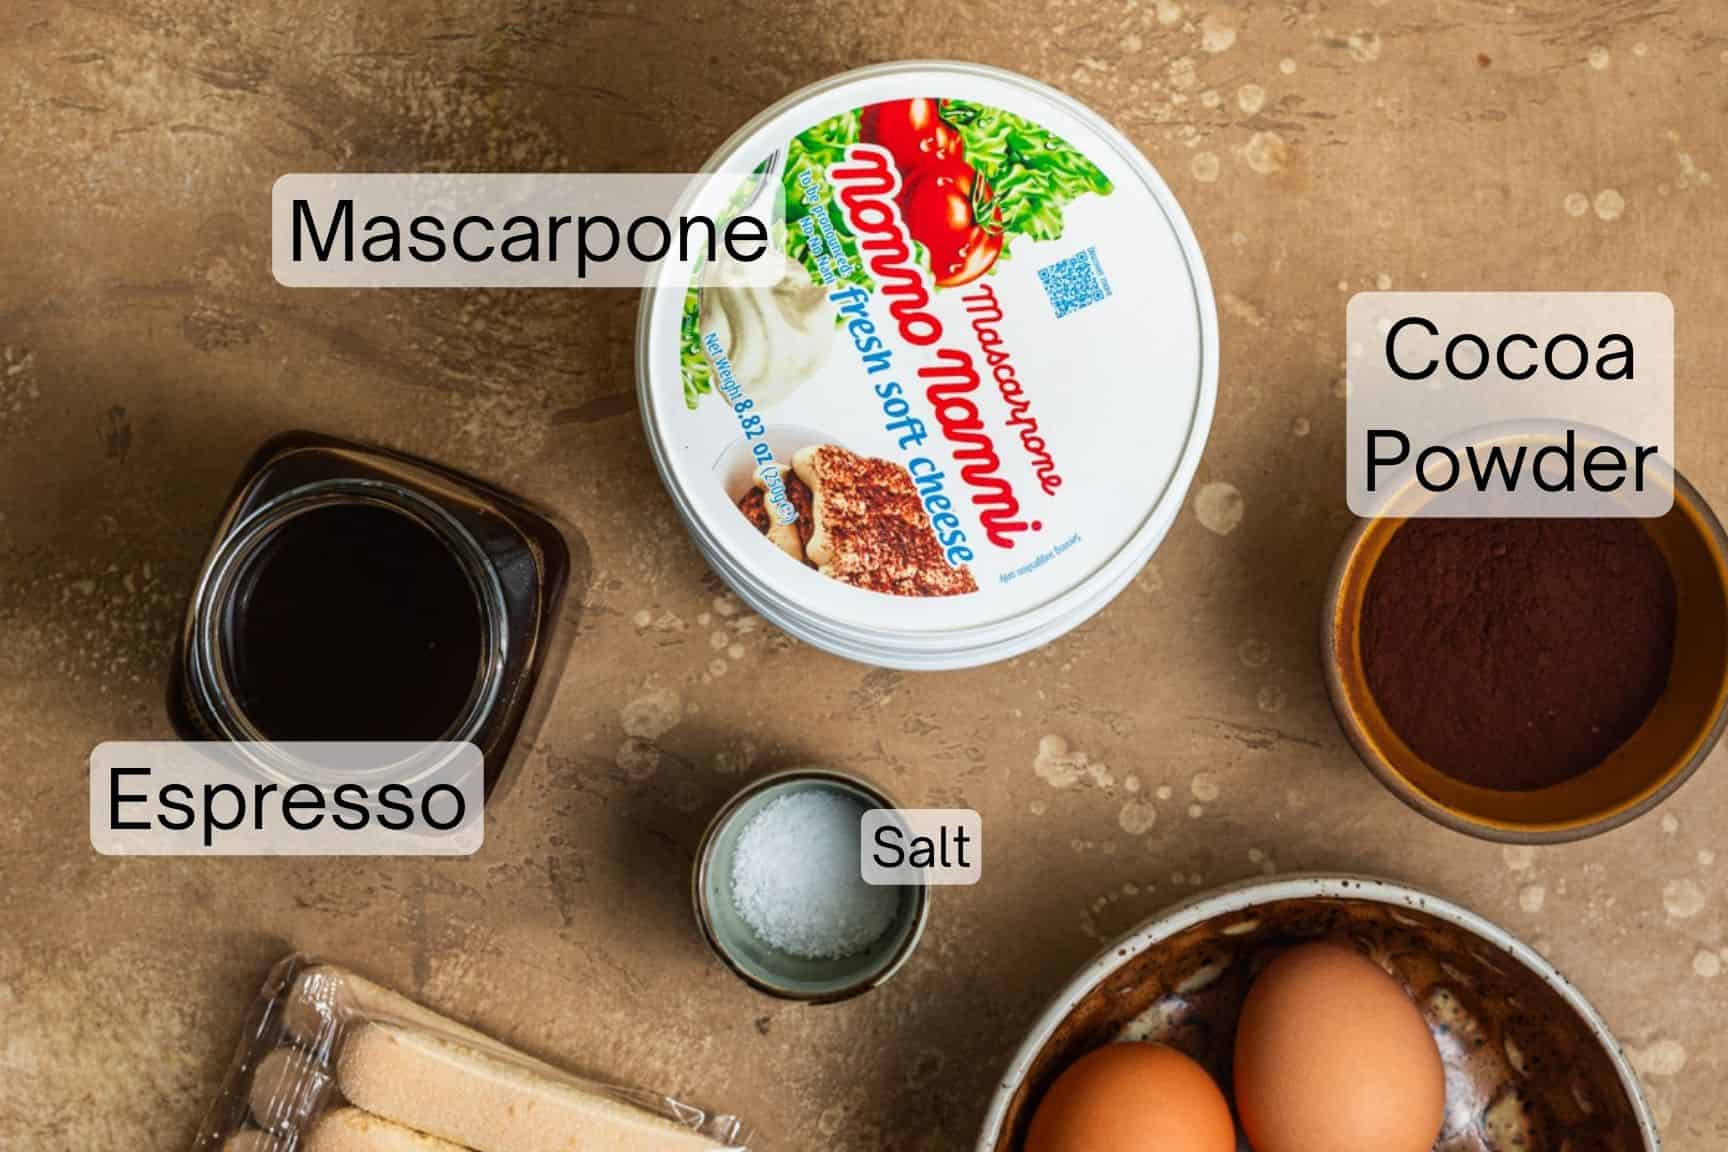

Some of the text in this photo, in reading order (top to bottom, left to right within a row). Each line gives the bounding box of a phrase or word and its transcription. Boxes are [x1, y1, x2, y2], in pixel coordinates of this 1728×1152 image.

[704, 331, 722, 357] Net
[714, 357, 742, 402] Weight
[733, 398, 765, 440] 8.82
[752, 442, 775, 466] oz
[829, 286, 974, 566] fresh soft cheese
[962, 283, 1062, 496] Mascarpone
